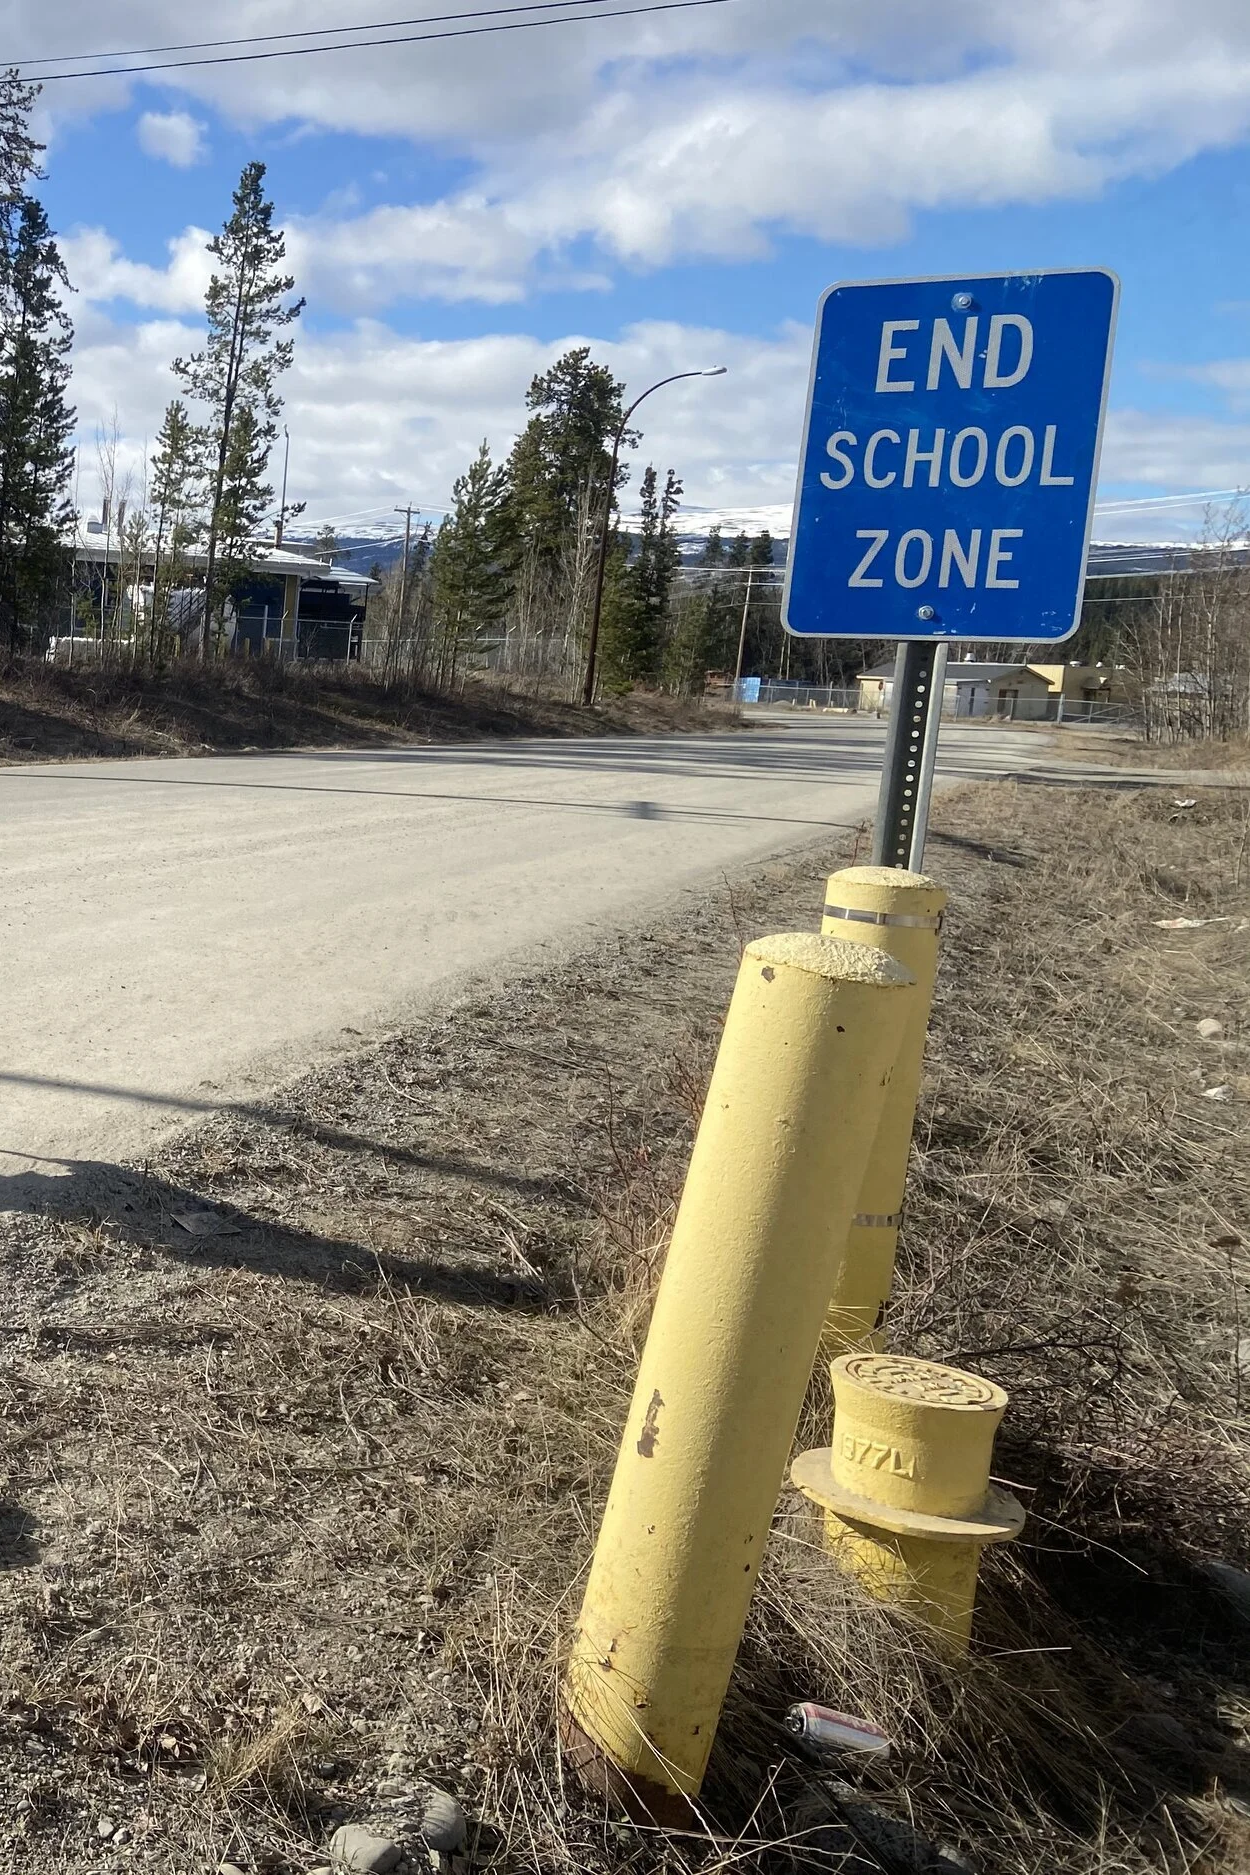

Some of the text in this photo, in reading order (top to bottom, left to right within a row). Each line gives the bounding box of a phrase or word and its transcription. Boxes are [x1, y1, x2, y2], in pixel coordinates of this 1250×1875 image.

[875, 314, 1034, 393] END
[820, 425, 1074, 490] SCHOOL
[848, 528, 1023, 589] ZONE
